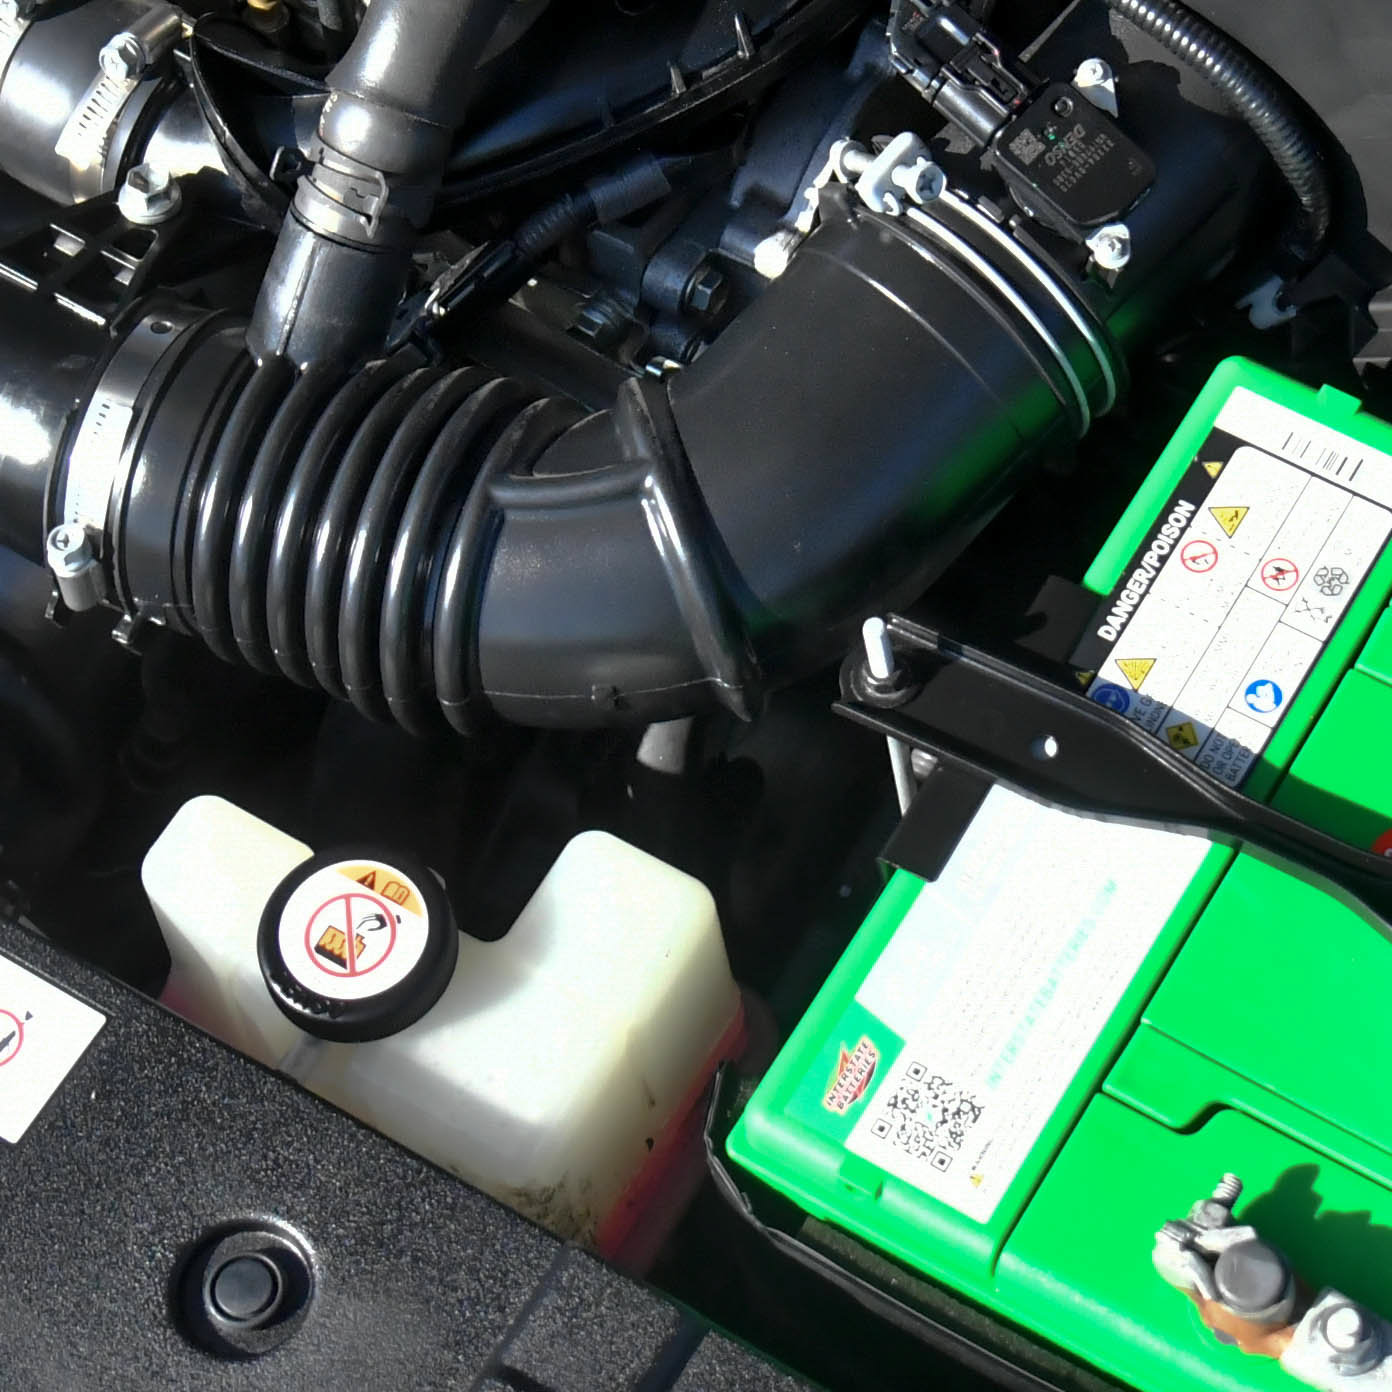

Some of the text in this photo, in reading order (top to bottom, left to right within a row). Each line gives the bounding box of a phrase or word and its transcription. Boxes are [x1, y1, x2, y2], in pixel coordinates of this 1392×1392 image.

[1044, 123, 1087, 167] DENSO
[1097, 499, 1197, 642] DANGER/POISON
[826, 1040, 868, 1106] INTERSTATE
[836, 1049, 876, 1110] BATTERIES
